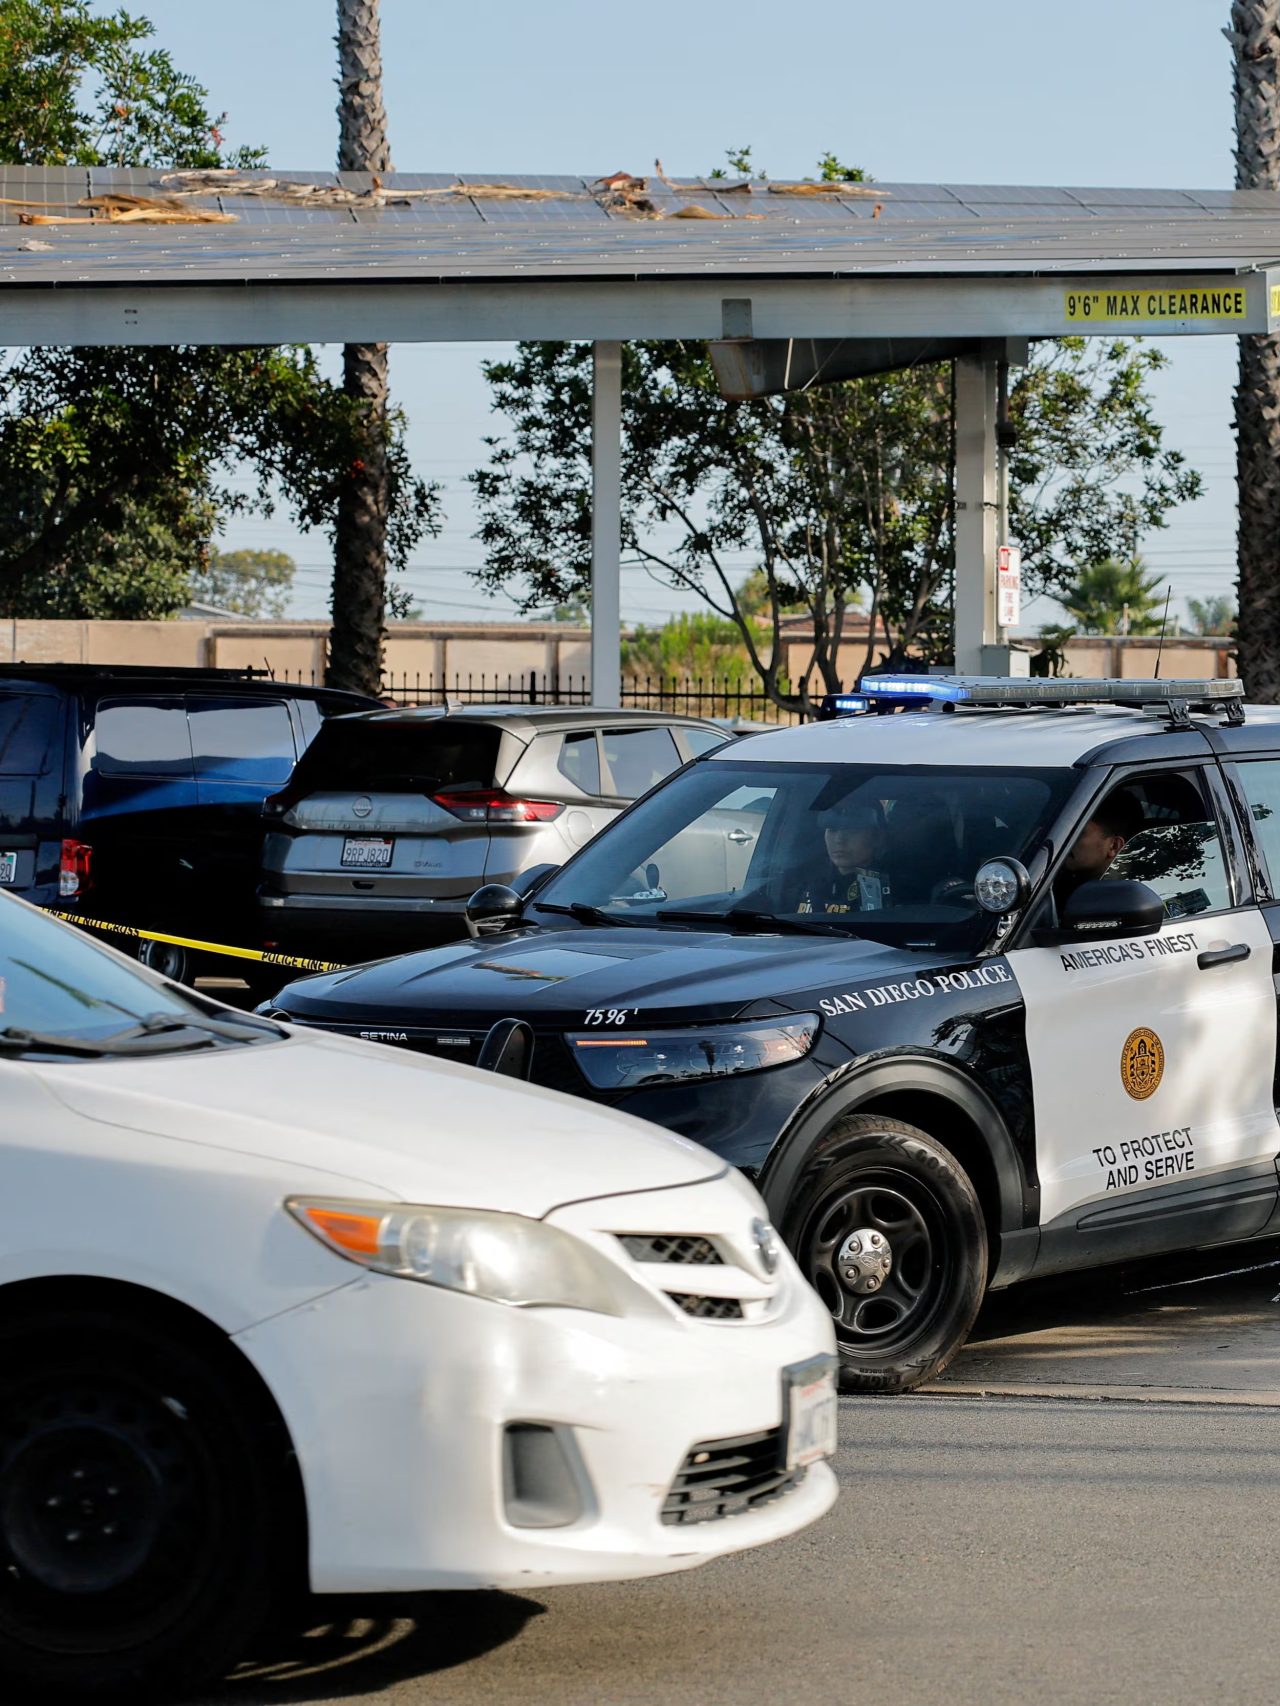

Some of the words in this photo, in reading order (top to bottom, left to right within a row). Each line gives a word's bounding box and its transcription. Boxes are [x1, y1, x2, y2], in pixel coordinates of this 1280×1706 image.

[1068, 295, 1099, 316] 9'6"
[1106, 294, 1141, 316] MAX
[1147, 292, 1243, 316] CLEARANCE
[345, 847, 389, 863] 9RPJ820
[262, 952, 298, 967] POLICE
[301, 958, 324, 971] LINE
[1060, 942, 1145, 971] AMERICA'S
[1143, 933, 1199, 956] FINEST
[819, 990, 869, 1017] SAN
[861, 978, 935, 1006] DIEGO
[935, 964, 1013, 994] POLICE
[584, 1009, 628, 1025] 7596
[360, 1031, 408, 1041] SETINA
[1092, 1147, 1117, 1168] TO
[1120, 1127, 1195, 1162] PROTECT
[1105, 1163, 1139, 1191] AND
[1144, 1151, 1195, 1181] SERVE
